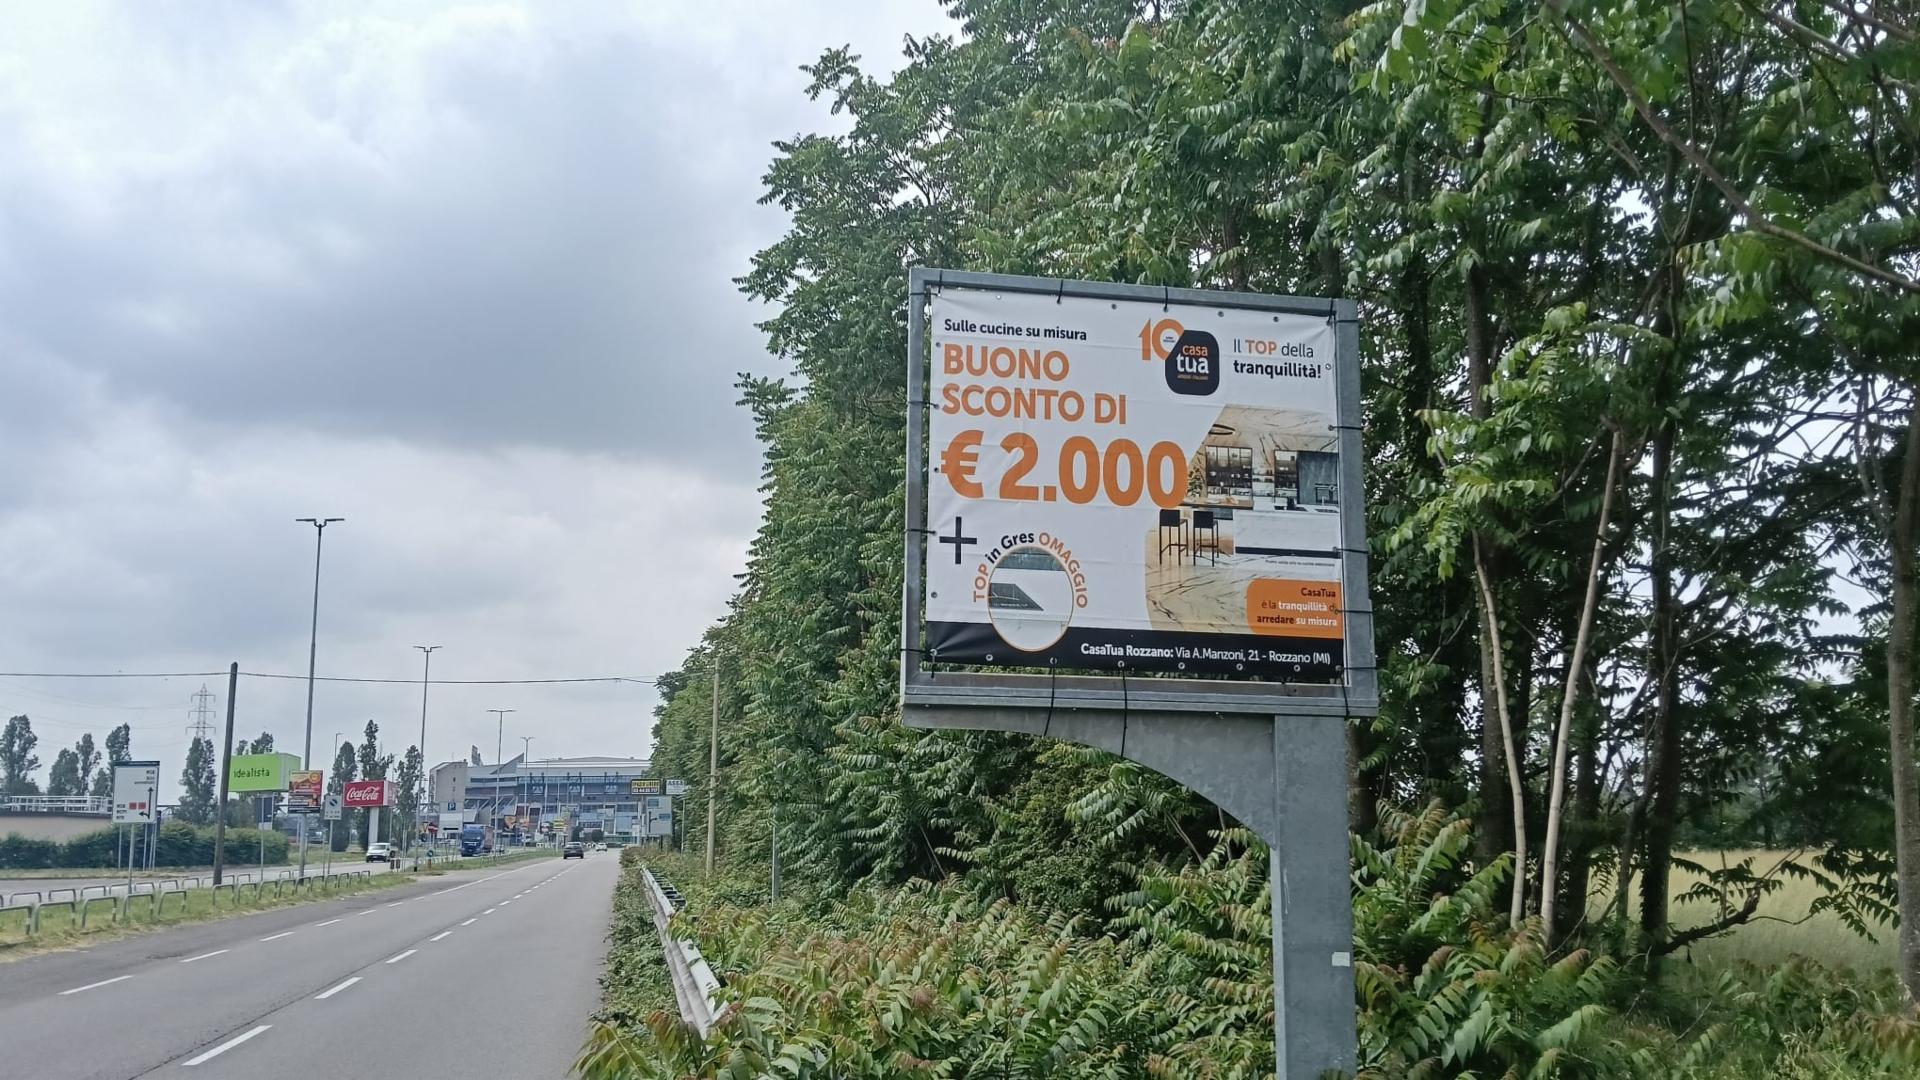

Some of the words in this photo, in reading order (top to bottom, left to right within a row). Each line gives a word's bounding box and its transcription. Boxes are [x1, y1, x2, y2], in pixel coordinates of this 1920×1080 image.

[944, 318, 977, 333] Sulle
[979, 322, 1023, 336] cucine
[1026, 327, 1040, 337] su
[1043, 326, 1087, 341] misura
[1182, 345, 1208, 357] casa
[1234, 338, 1242, 353] Il
[1245, 339, 1277, 355] TOP
[1281, 342, 1314, 358] della
[943, 343, 1070, 382] BUONO
[1176, 353, 1209, 375] tua
[1233, 360, 1321, 379] tranquillità!
[942, 383, 1085, 422] SCONTO
[1094, 393, 1127, 425] DI
[940, 429, 984, 499] €
[1000, 432, 1188, 509] 2.000
[973, 563, 989, 603] TOP
[985, 548, 1001, 564] in
[1001, 532, 1035, 550] Gres
[1039, 532, 1088, 609] OMAGGIO
[1301, 588, 1336, 598] CasaTua
[1269, 601, 1277, 610] la
[1278, 602, 1328, 613] tranquillità
[1257, 615, 1294, 625] arredare
[1296, 617, 1307, 626] su
[1308, 616, 1338, 627] misura
[1081, 643, 1124, 656] CasaTua
[1126, 645, 1174, 658] Rozzano:
[1175, 647, 1191, 659] Via
[1192, 648, 1245, 662] A.Manzoni,
[1248, 650, 1259, 661] 21
[1269, 651, 1311, 663] Rozzano
[233, 768, 270, 778] idealista
